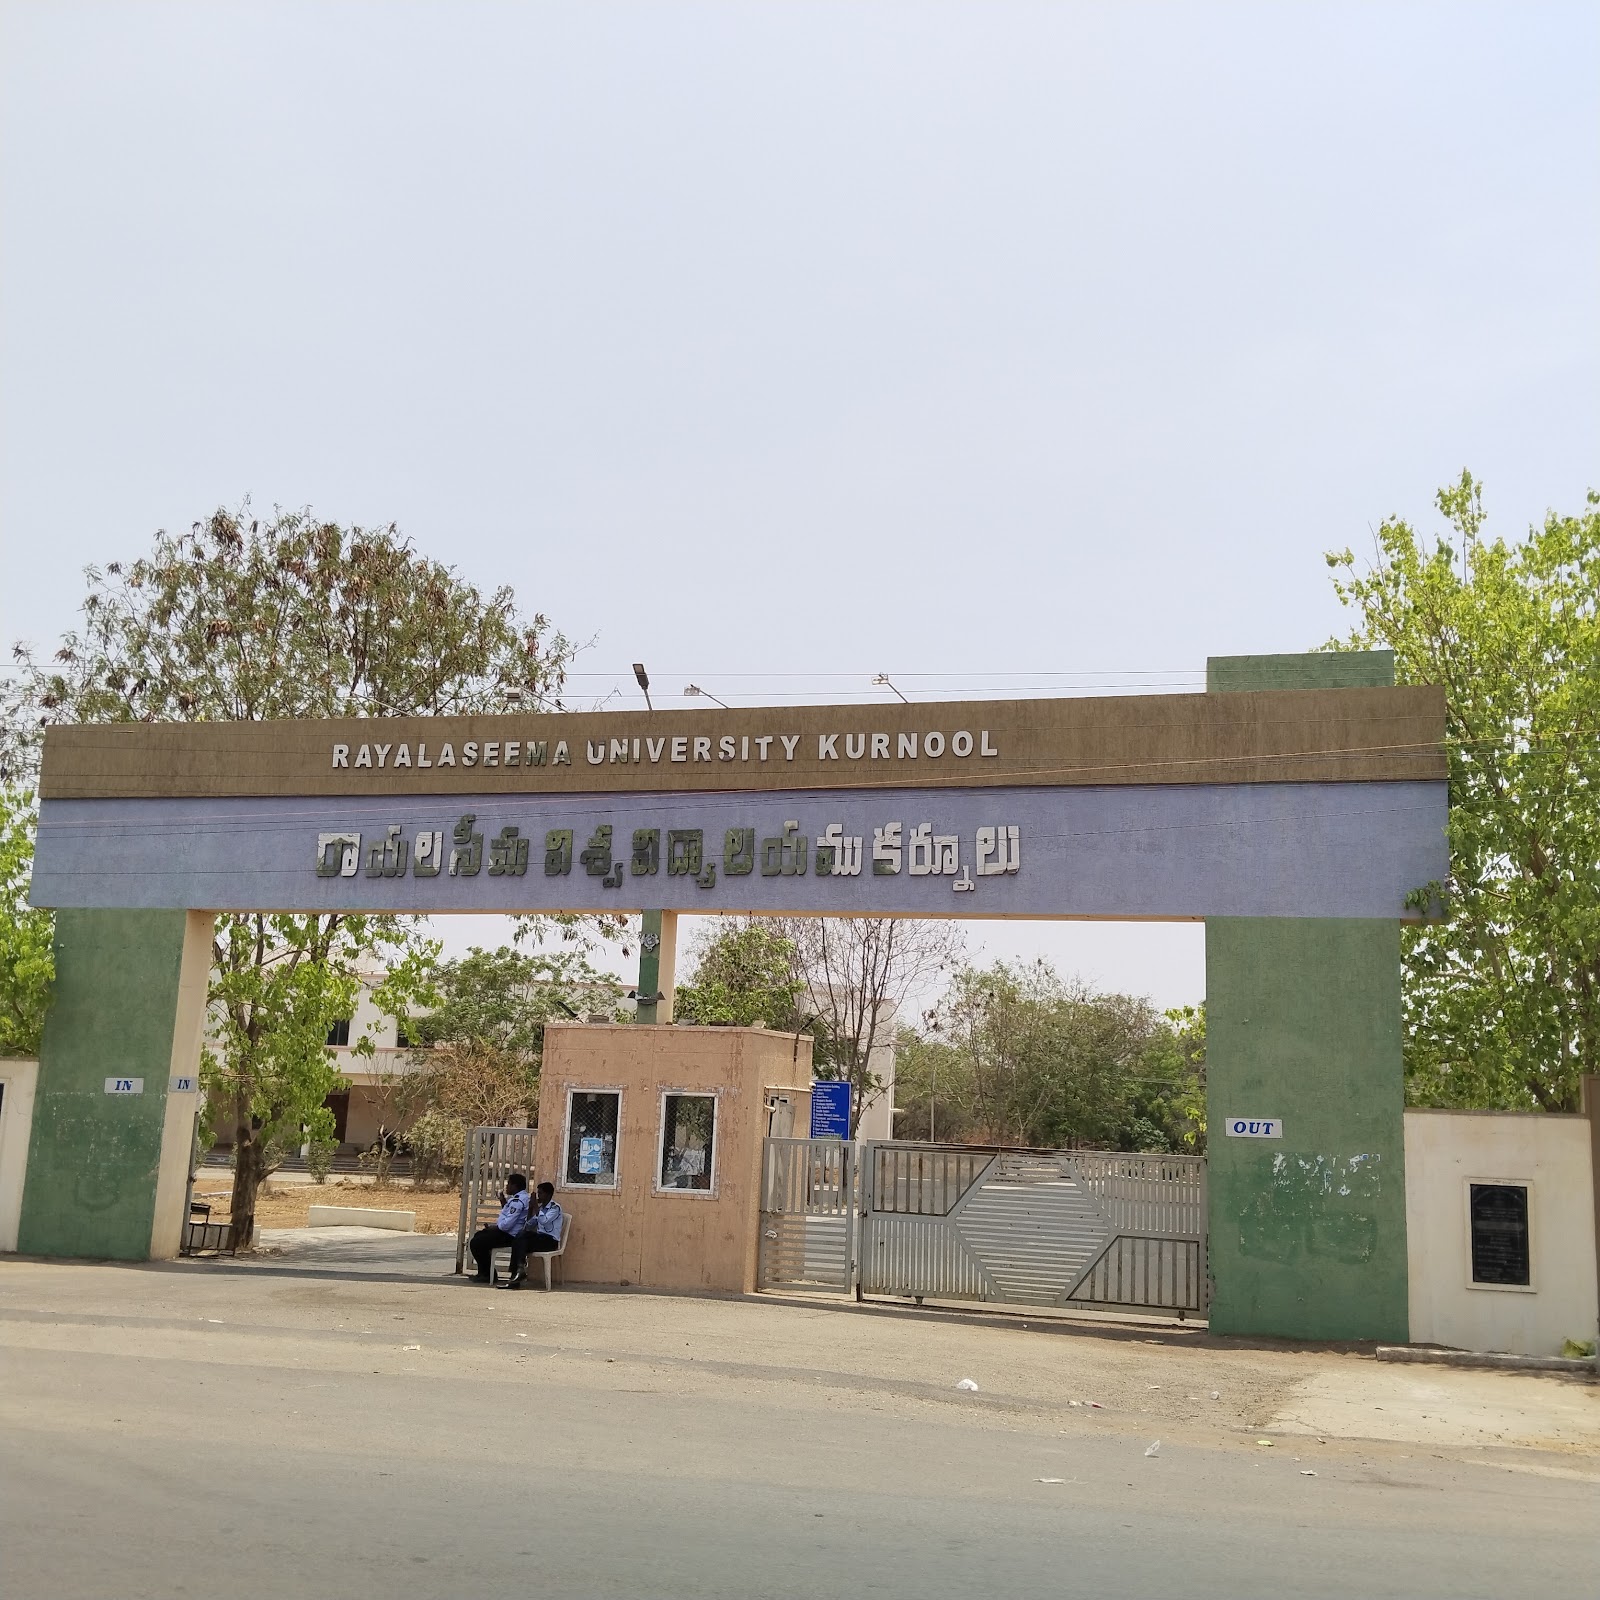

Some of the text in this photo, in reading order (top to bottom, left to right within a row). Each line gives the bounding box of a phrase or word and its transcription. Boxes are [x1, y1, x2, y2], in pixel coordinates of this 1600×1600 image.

[332, 730, 998, 769] RAYALASEEMA UNIVERSITY KURNOOL
[315, 813, 530, 878] రాయలసీమ
[114, 1080, 133, 1091] IN
[177, 1079, 190, 1090] IN
[1233, 1121, 1274, 1135] OUT
